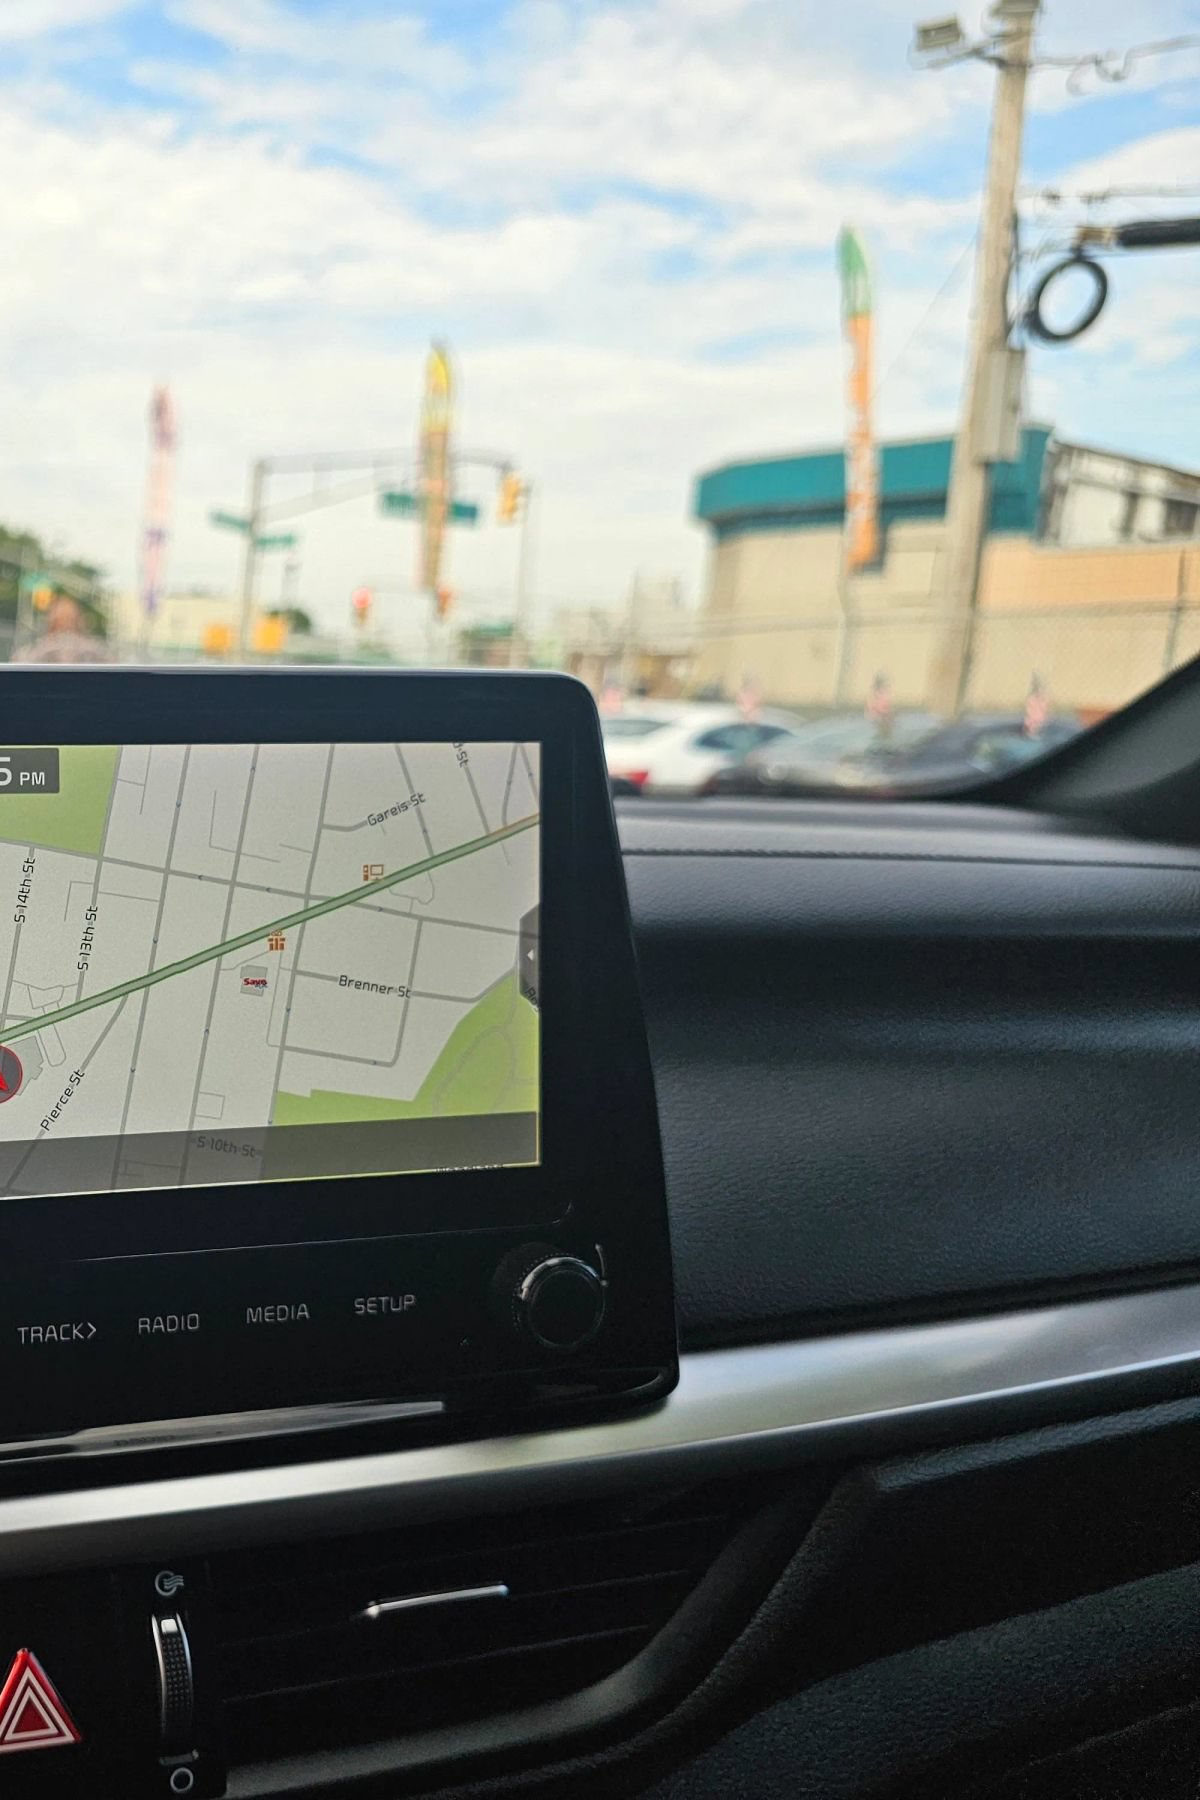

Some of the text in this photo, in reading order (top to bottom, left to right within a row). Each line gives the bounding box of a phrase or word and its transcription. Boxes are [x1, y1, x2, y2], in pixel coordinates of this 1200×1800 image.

[19, 772, 45, 786] PM
[367, 793, 426, 826] Gareis St
[14, 856, 36, 924] S 14th St
[77, 905, 98, 971] S 13th St
[339, 976, 412, 999] Brenner St
[40, 1069, 85, 1131] Pierce St
[197, 1136, 256, 1158] S 10th St
[246, 1303, 310, 1324] MEDIA
[354, 1294, 416, 1316] SETUP
[138, 1313, 200, 1335] RADIO
